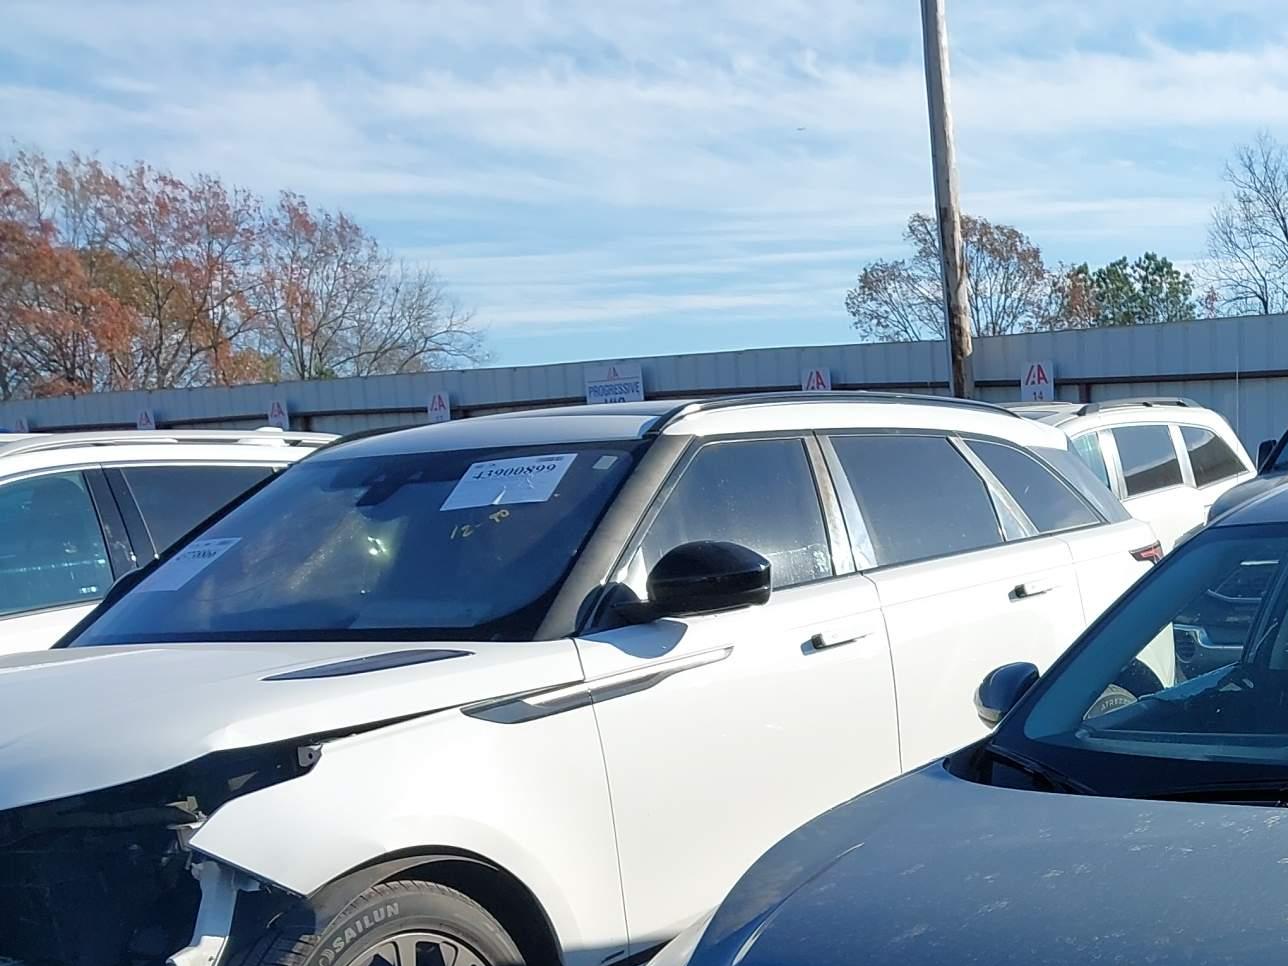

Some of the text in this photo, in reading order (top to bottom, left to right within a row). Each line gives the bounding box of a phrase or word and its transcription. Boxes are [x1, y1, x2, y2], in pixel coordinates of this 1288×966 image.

[588, 381, 641, 399] PROGRESSIVE
[473, 464, 557, 480] 43900899
[332, 903, 400, 953] SAILUN
